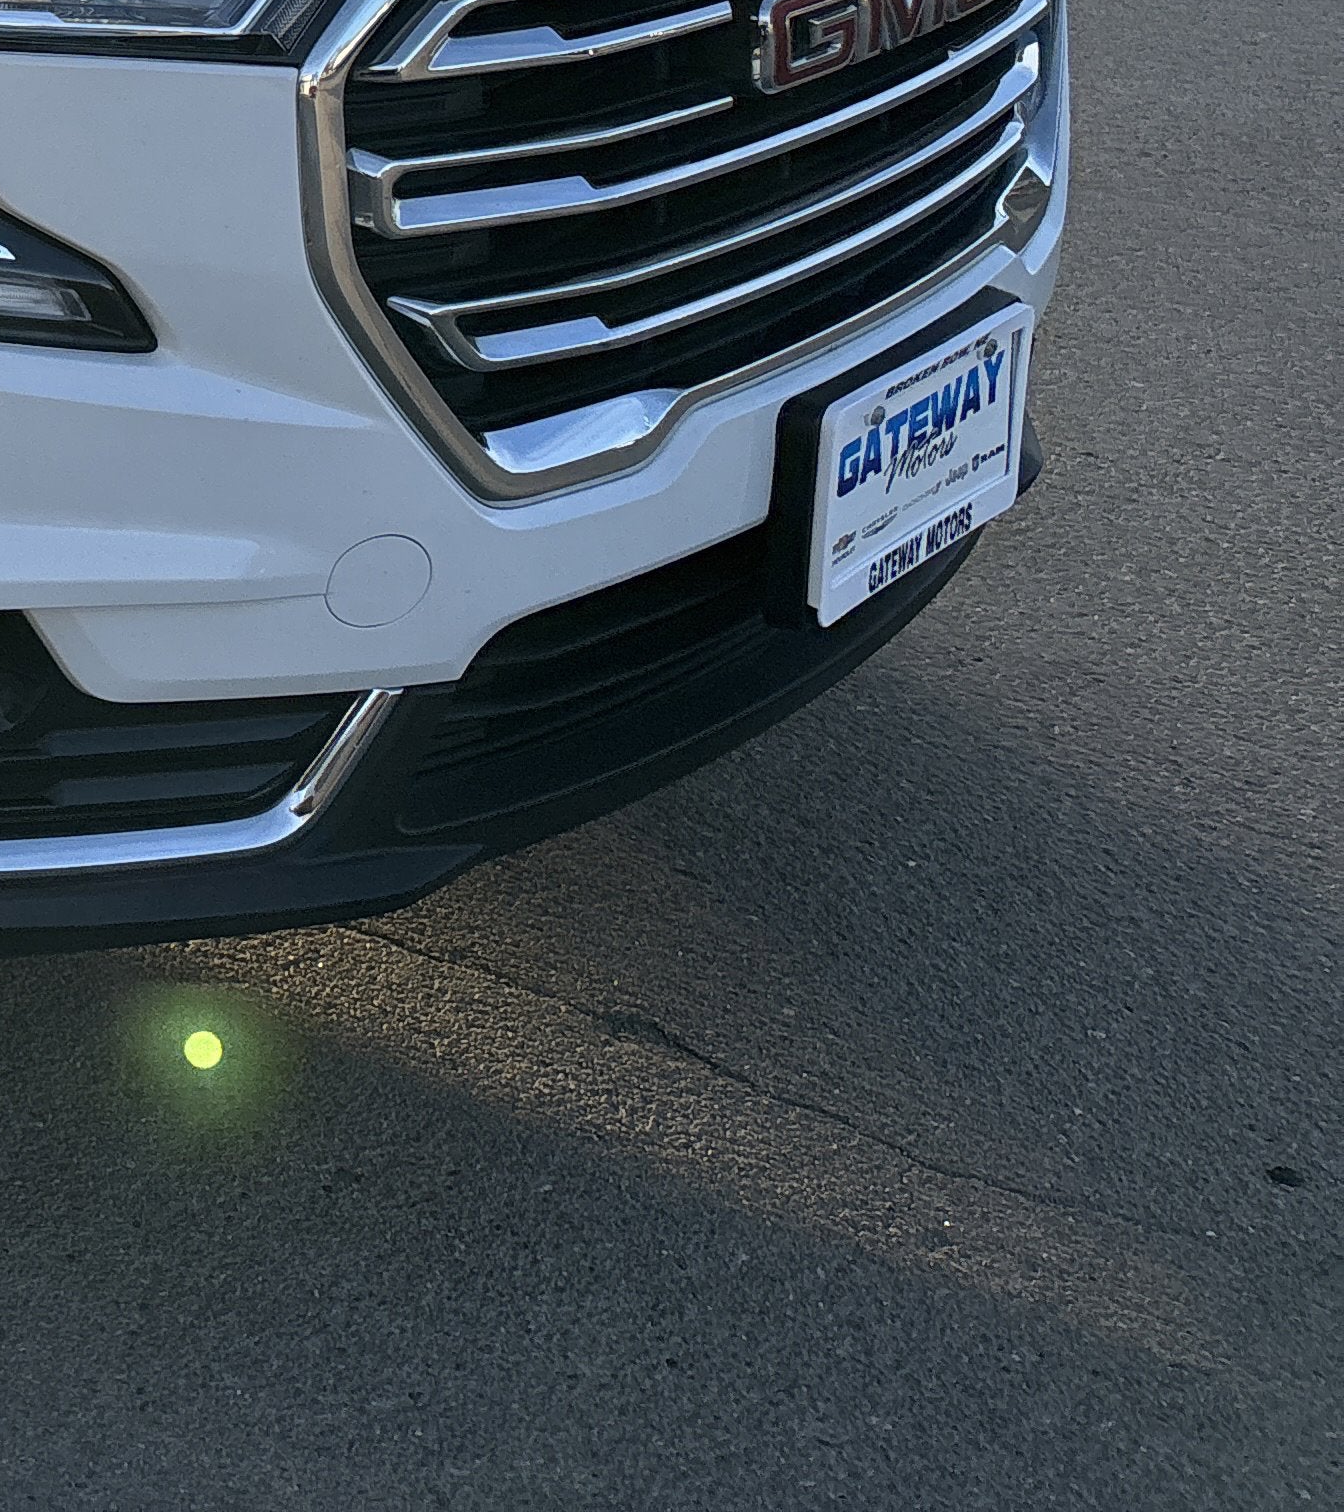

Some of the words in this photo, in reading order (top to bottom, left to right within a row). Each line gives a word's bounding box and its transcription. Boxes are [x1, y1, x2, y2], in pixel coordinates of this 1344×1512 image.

[837, 350, 1006, 498] GATEWAY
[883, 427, 958, 495] Motors
[868, 532, 923, 593] GATEWAY
[925, 502, 973, 557] MOTORS
